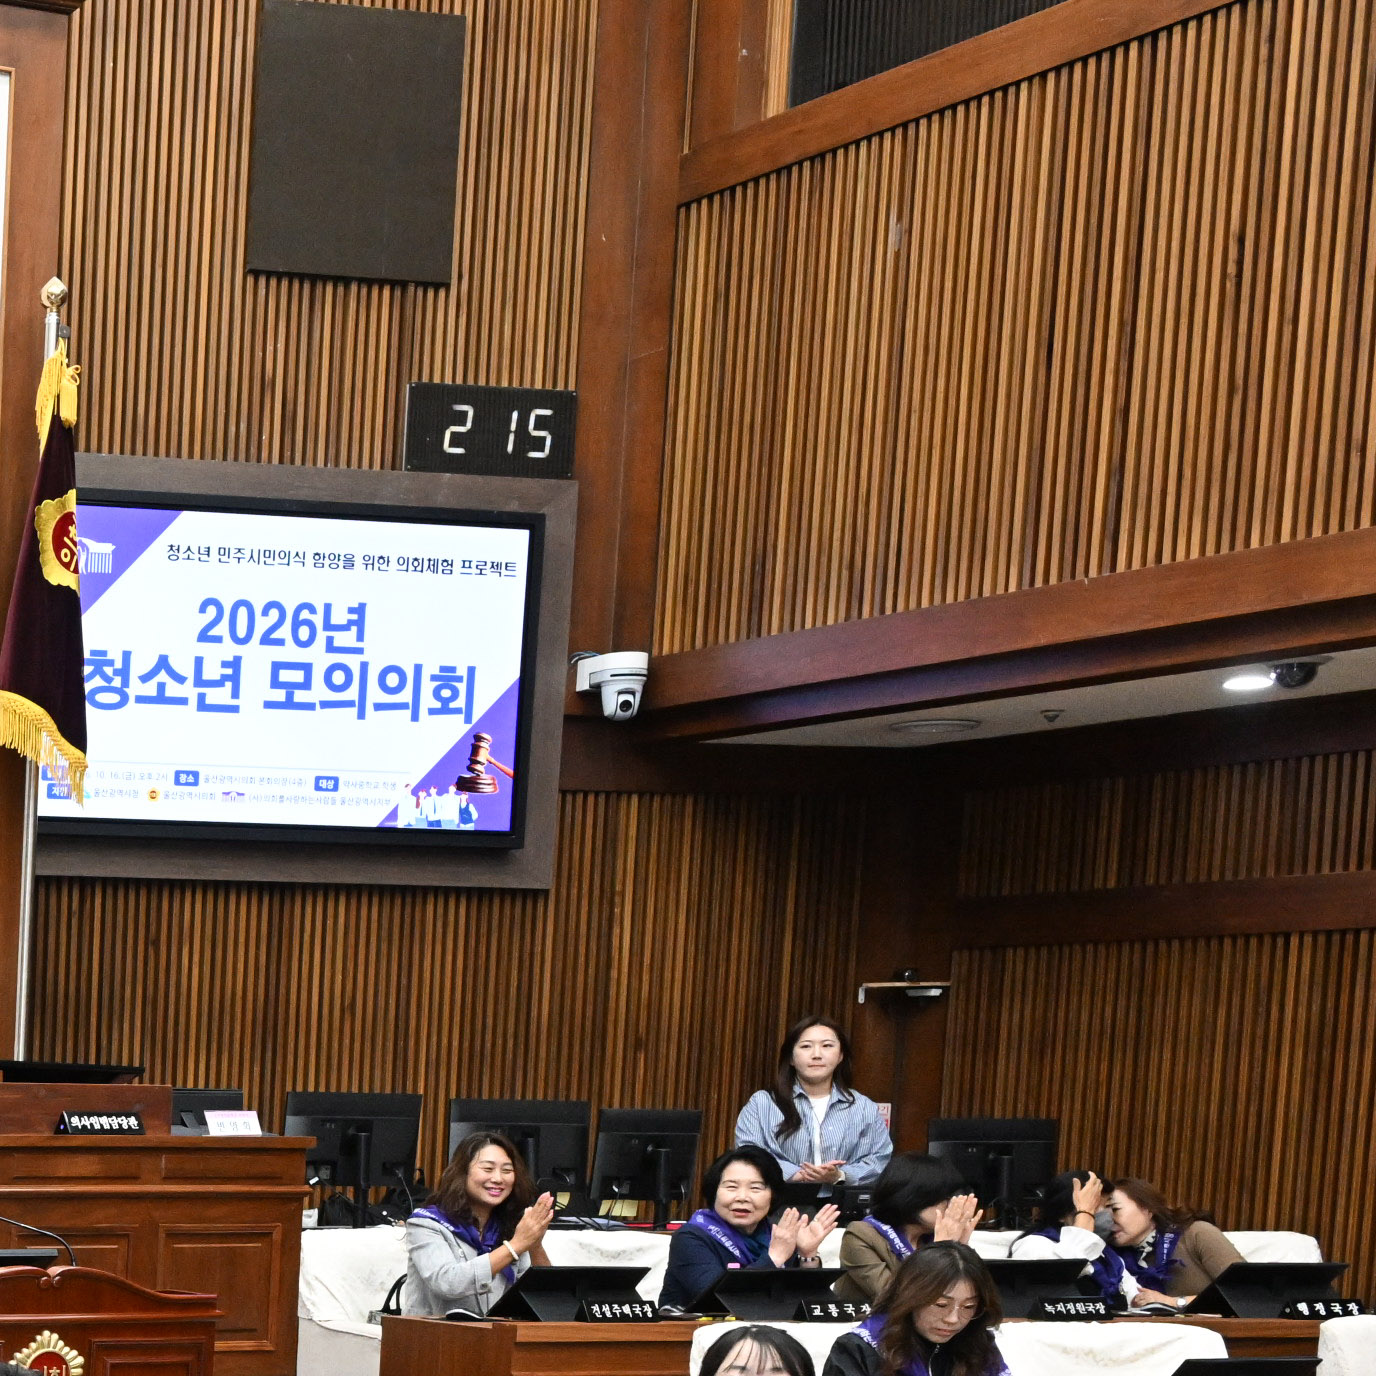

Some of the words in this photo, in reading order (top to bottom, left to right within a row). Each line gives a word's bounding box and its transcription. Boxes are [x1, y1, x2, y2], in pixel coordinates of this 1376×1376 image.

[166, 543, 212, 563] 청소년
[217, 546, 307, 567] 민주시민의식
[312, 551, 357, 571] 함양을
[361, 553, 391, 573] 위한
[396, 555, 454, 576] 의회체험
[459, 559, 518, 578] 프로젝트
[195, 597, 367, 655] 2026년
[84, 649, 243, 714] 청소년
[262, 660, 477, 725] 모의의회
[318, 778, 335, 790] 대상
[810, 1303, 872, 1317] 교통국장
[1044, 1302, 1106, 1315] 녹지정원국장
